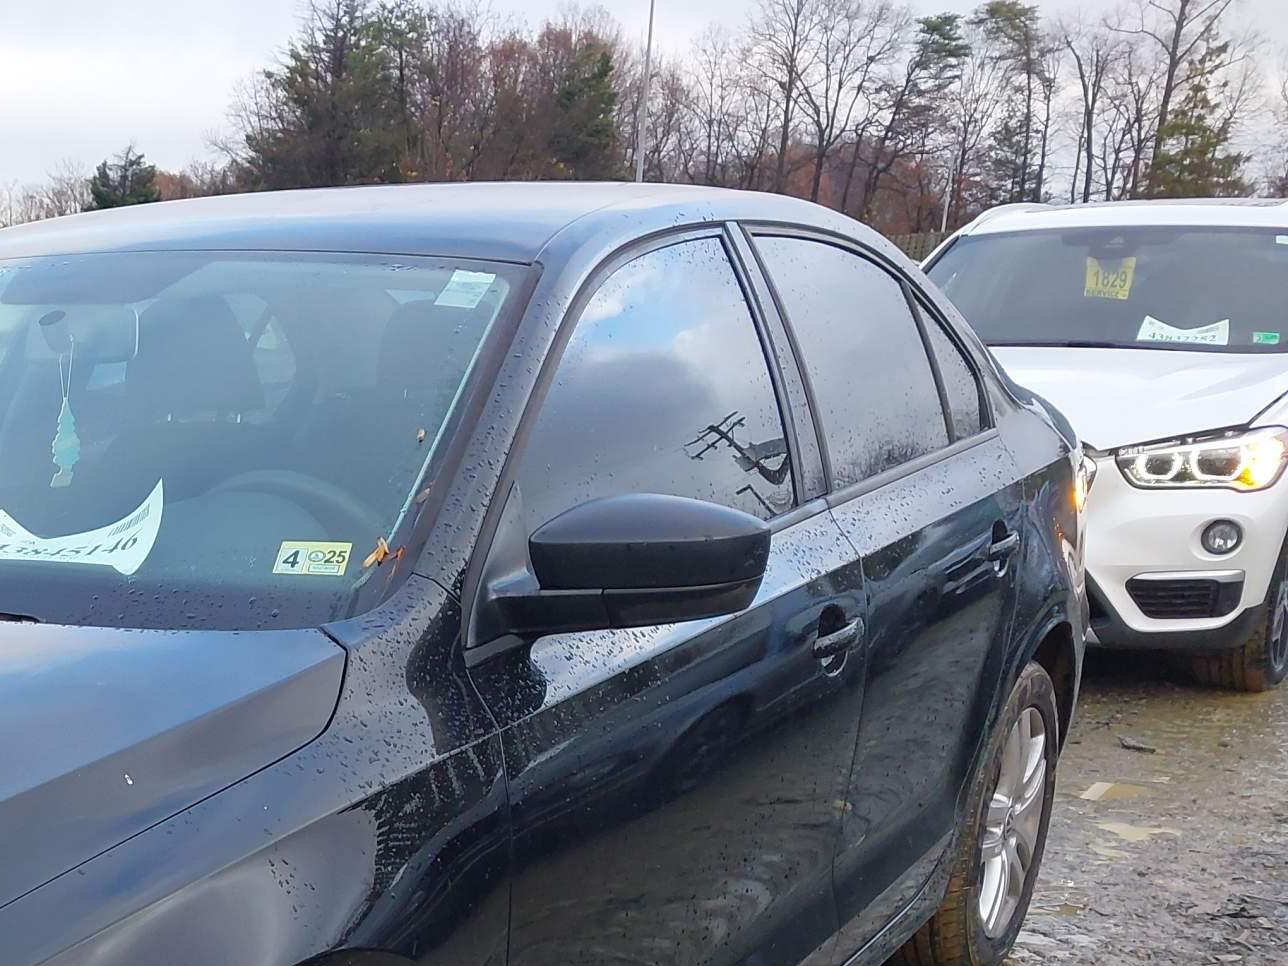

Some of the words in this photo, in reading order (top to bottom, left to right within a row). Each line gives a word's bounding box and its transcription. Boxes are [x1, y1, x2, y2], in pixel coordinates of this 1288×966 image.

[1093, 270, 1128, 289] 1829
[282, 549, 300, 568] 4
[324, 550, 348, 564] 25
